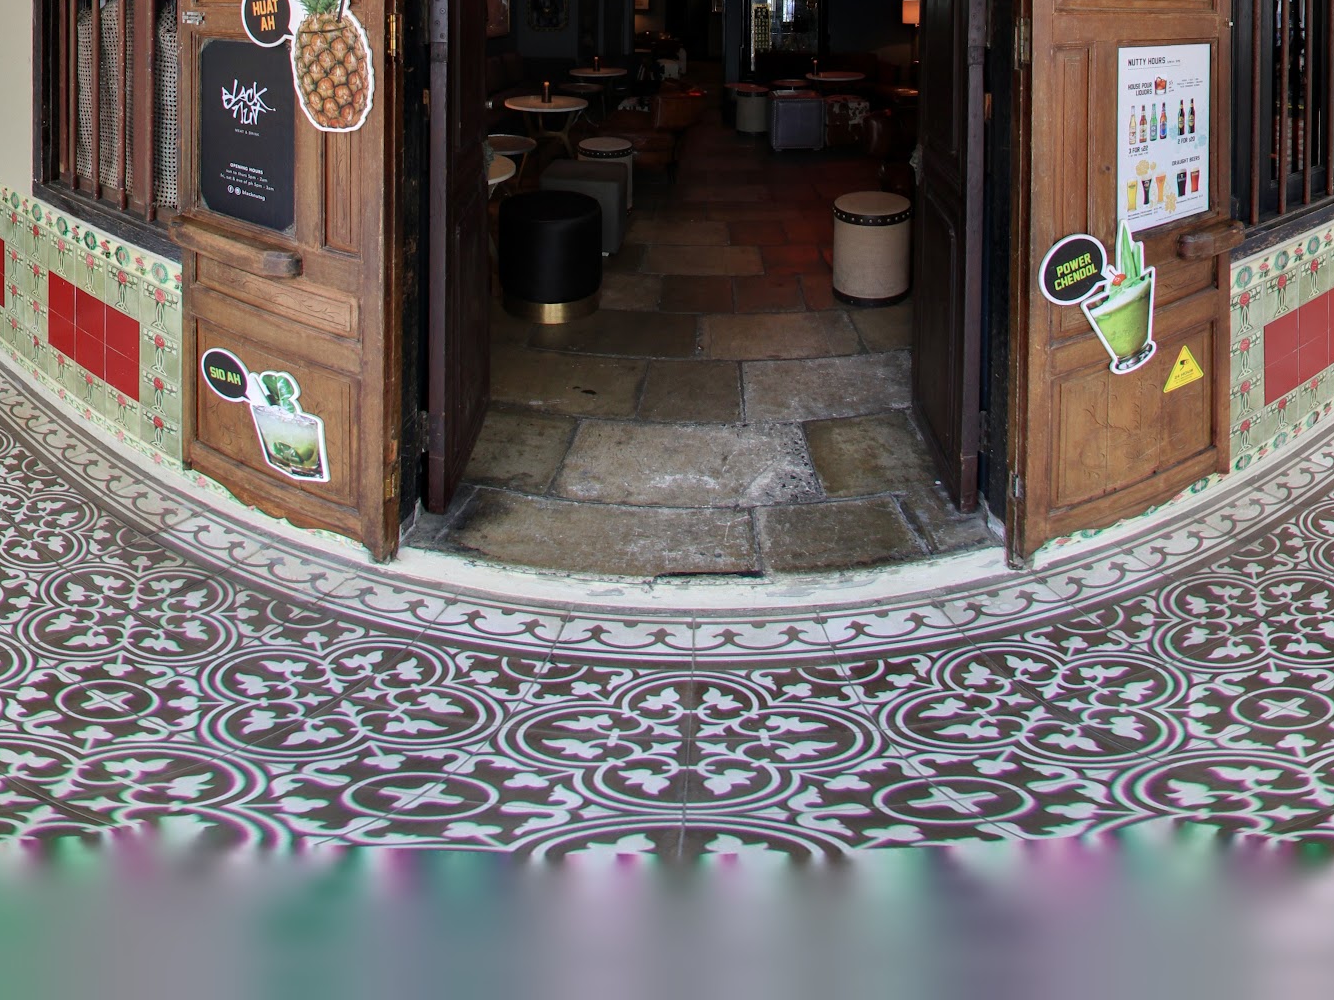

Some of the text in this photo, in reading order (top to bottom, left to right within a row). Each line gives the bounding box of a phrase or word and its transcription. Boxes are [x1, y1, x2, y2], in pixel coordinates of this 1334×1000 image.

[261, 15, 275, 31] AH
[1128, 58, 1146, 66] NUTTY
[1148, 56, 1165, 65] HOURS
[230, 163, 264, 175] OPENING HOURS
[1172, 158, 1189, 166] DRAUGHT
[1056, 253, 1091, 277] POWER
[1054, 263, 1098, 290] CHENDOL
[210, 366, 241, 386] SIO AH
